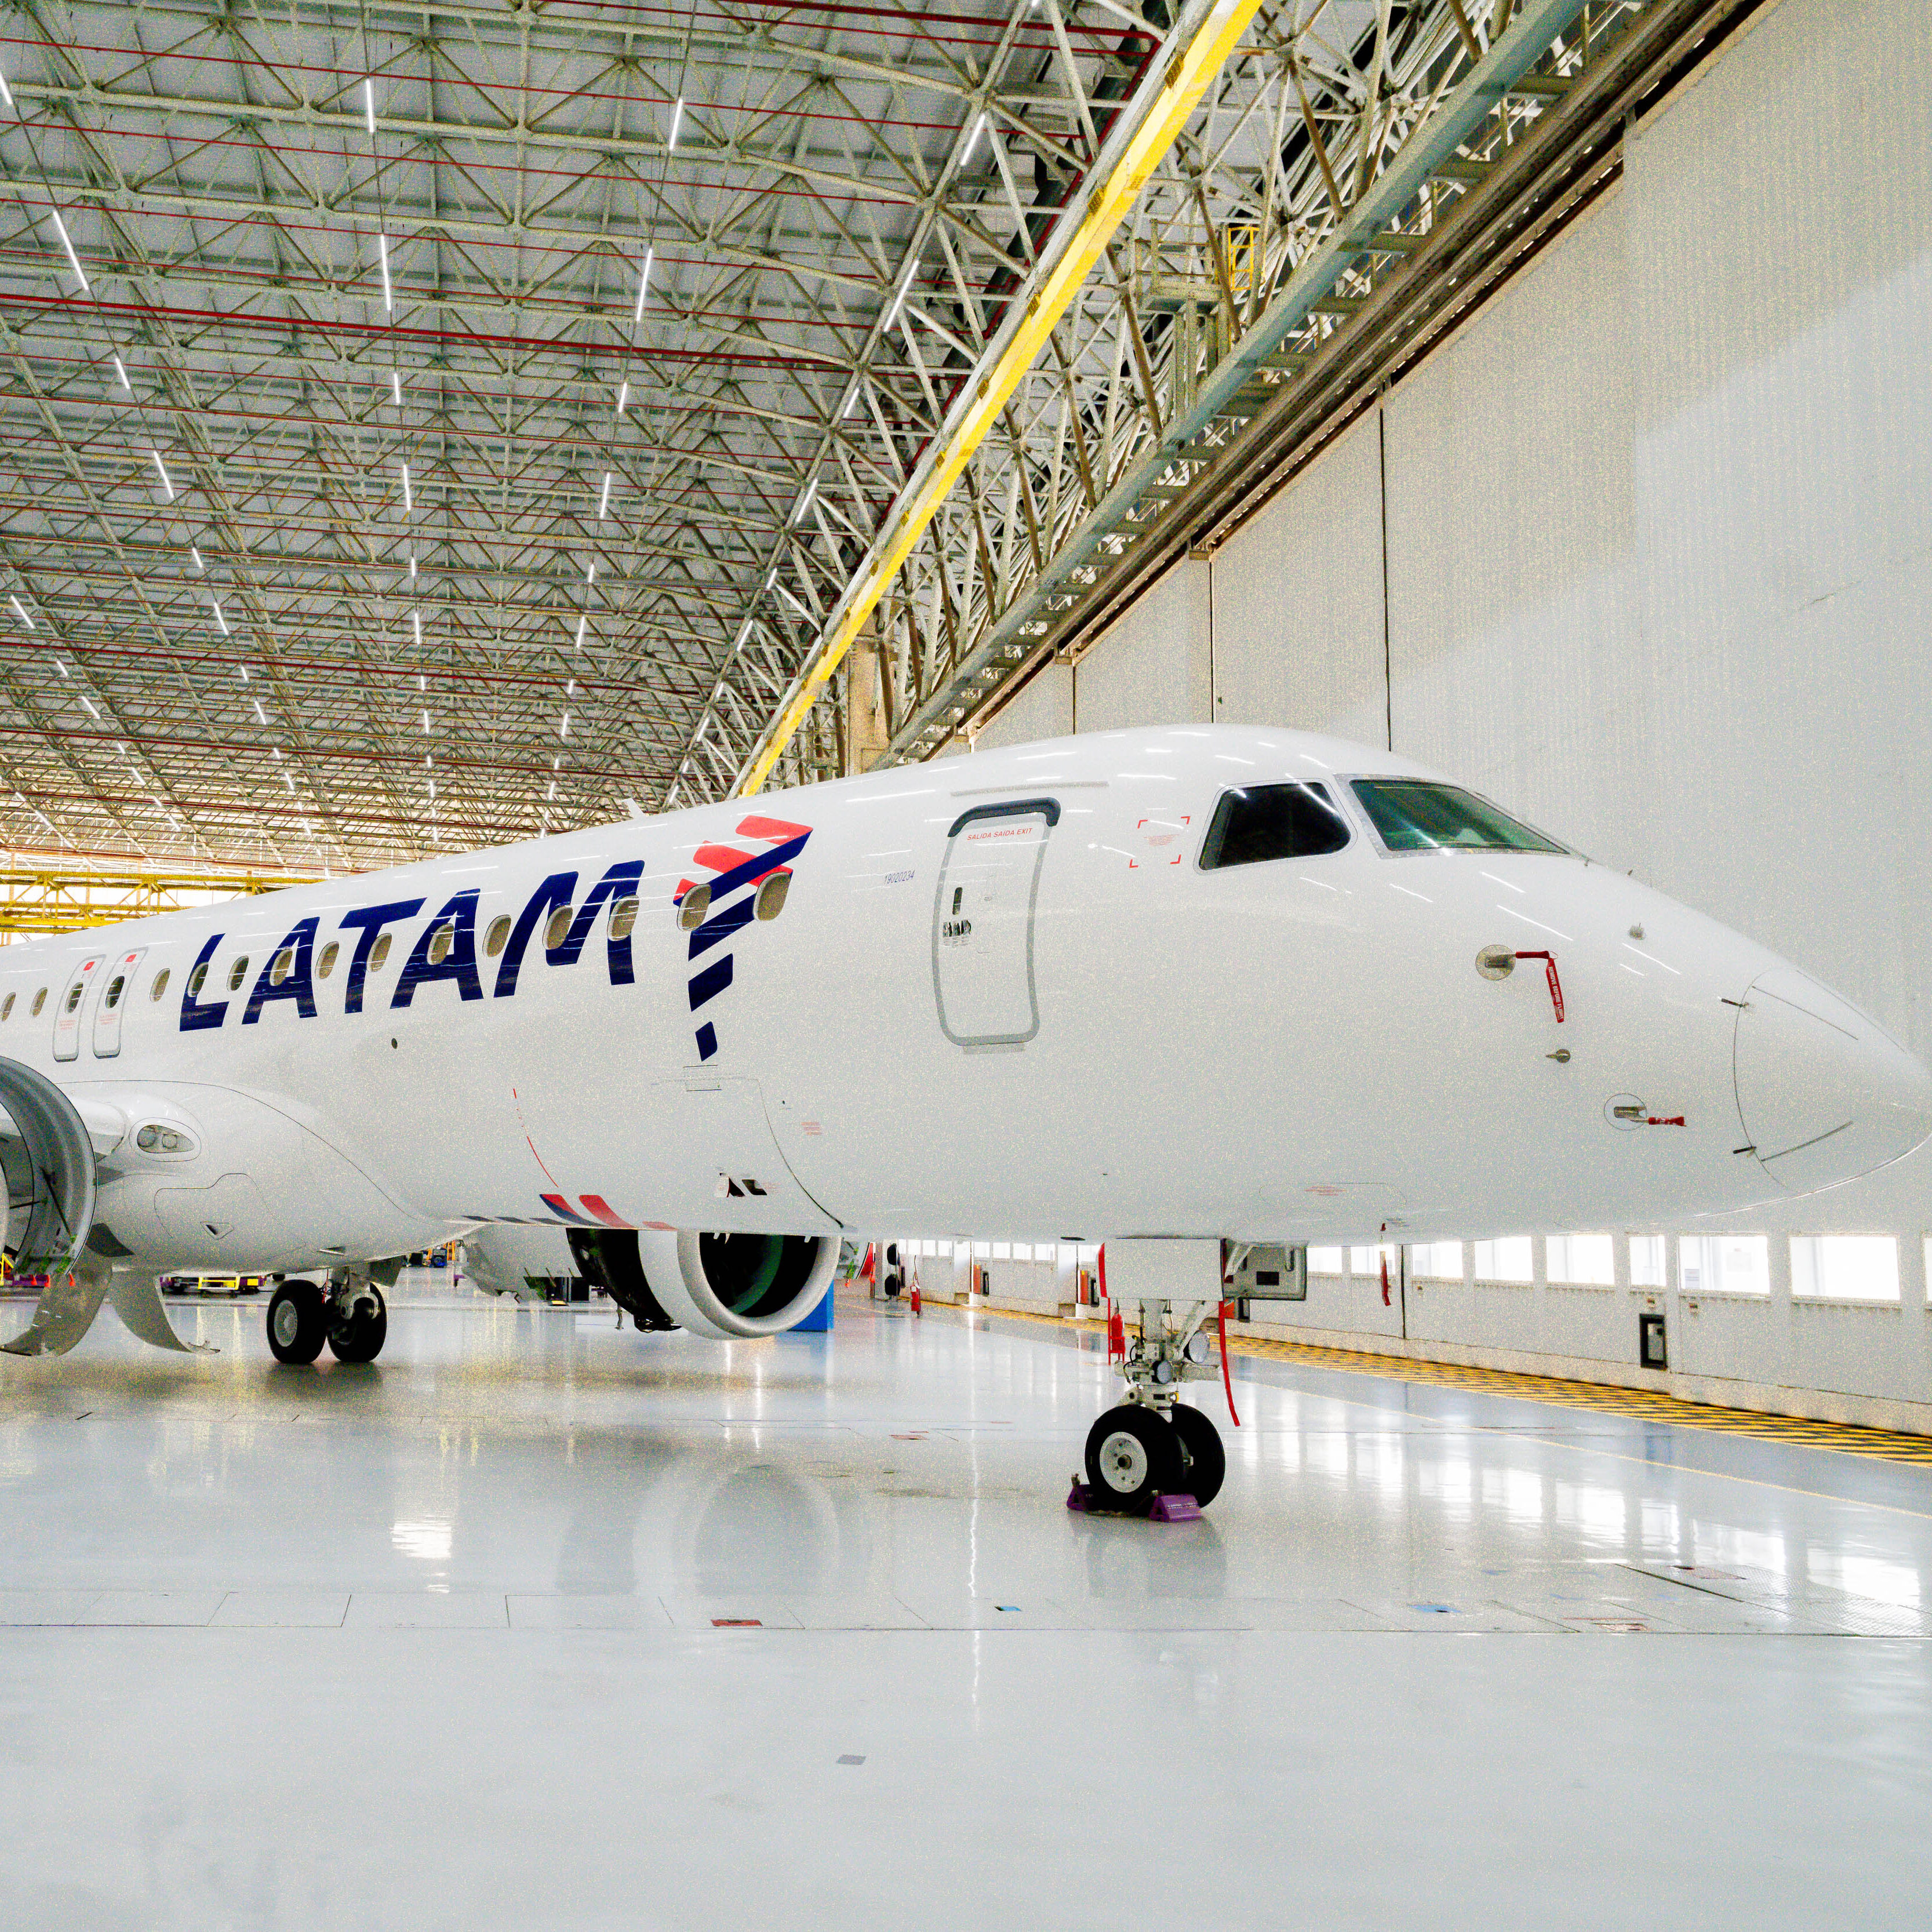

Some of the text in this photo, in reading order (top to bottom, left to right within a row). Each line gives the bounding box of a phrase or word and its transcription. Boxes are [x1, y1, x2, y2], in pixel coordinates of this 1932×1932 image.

[967, 832, 991, 841] SALIDA
[884, 870, 915, 885] 19020234
[180, 860, 645, 1031] LATAM
[1549, 966, 1557, 985] REMOVE
[1553, 985, 1561, 1003] BEFORE
